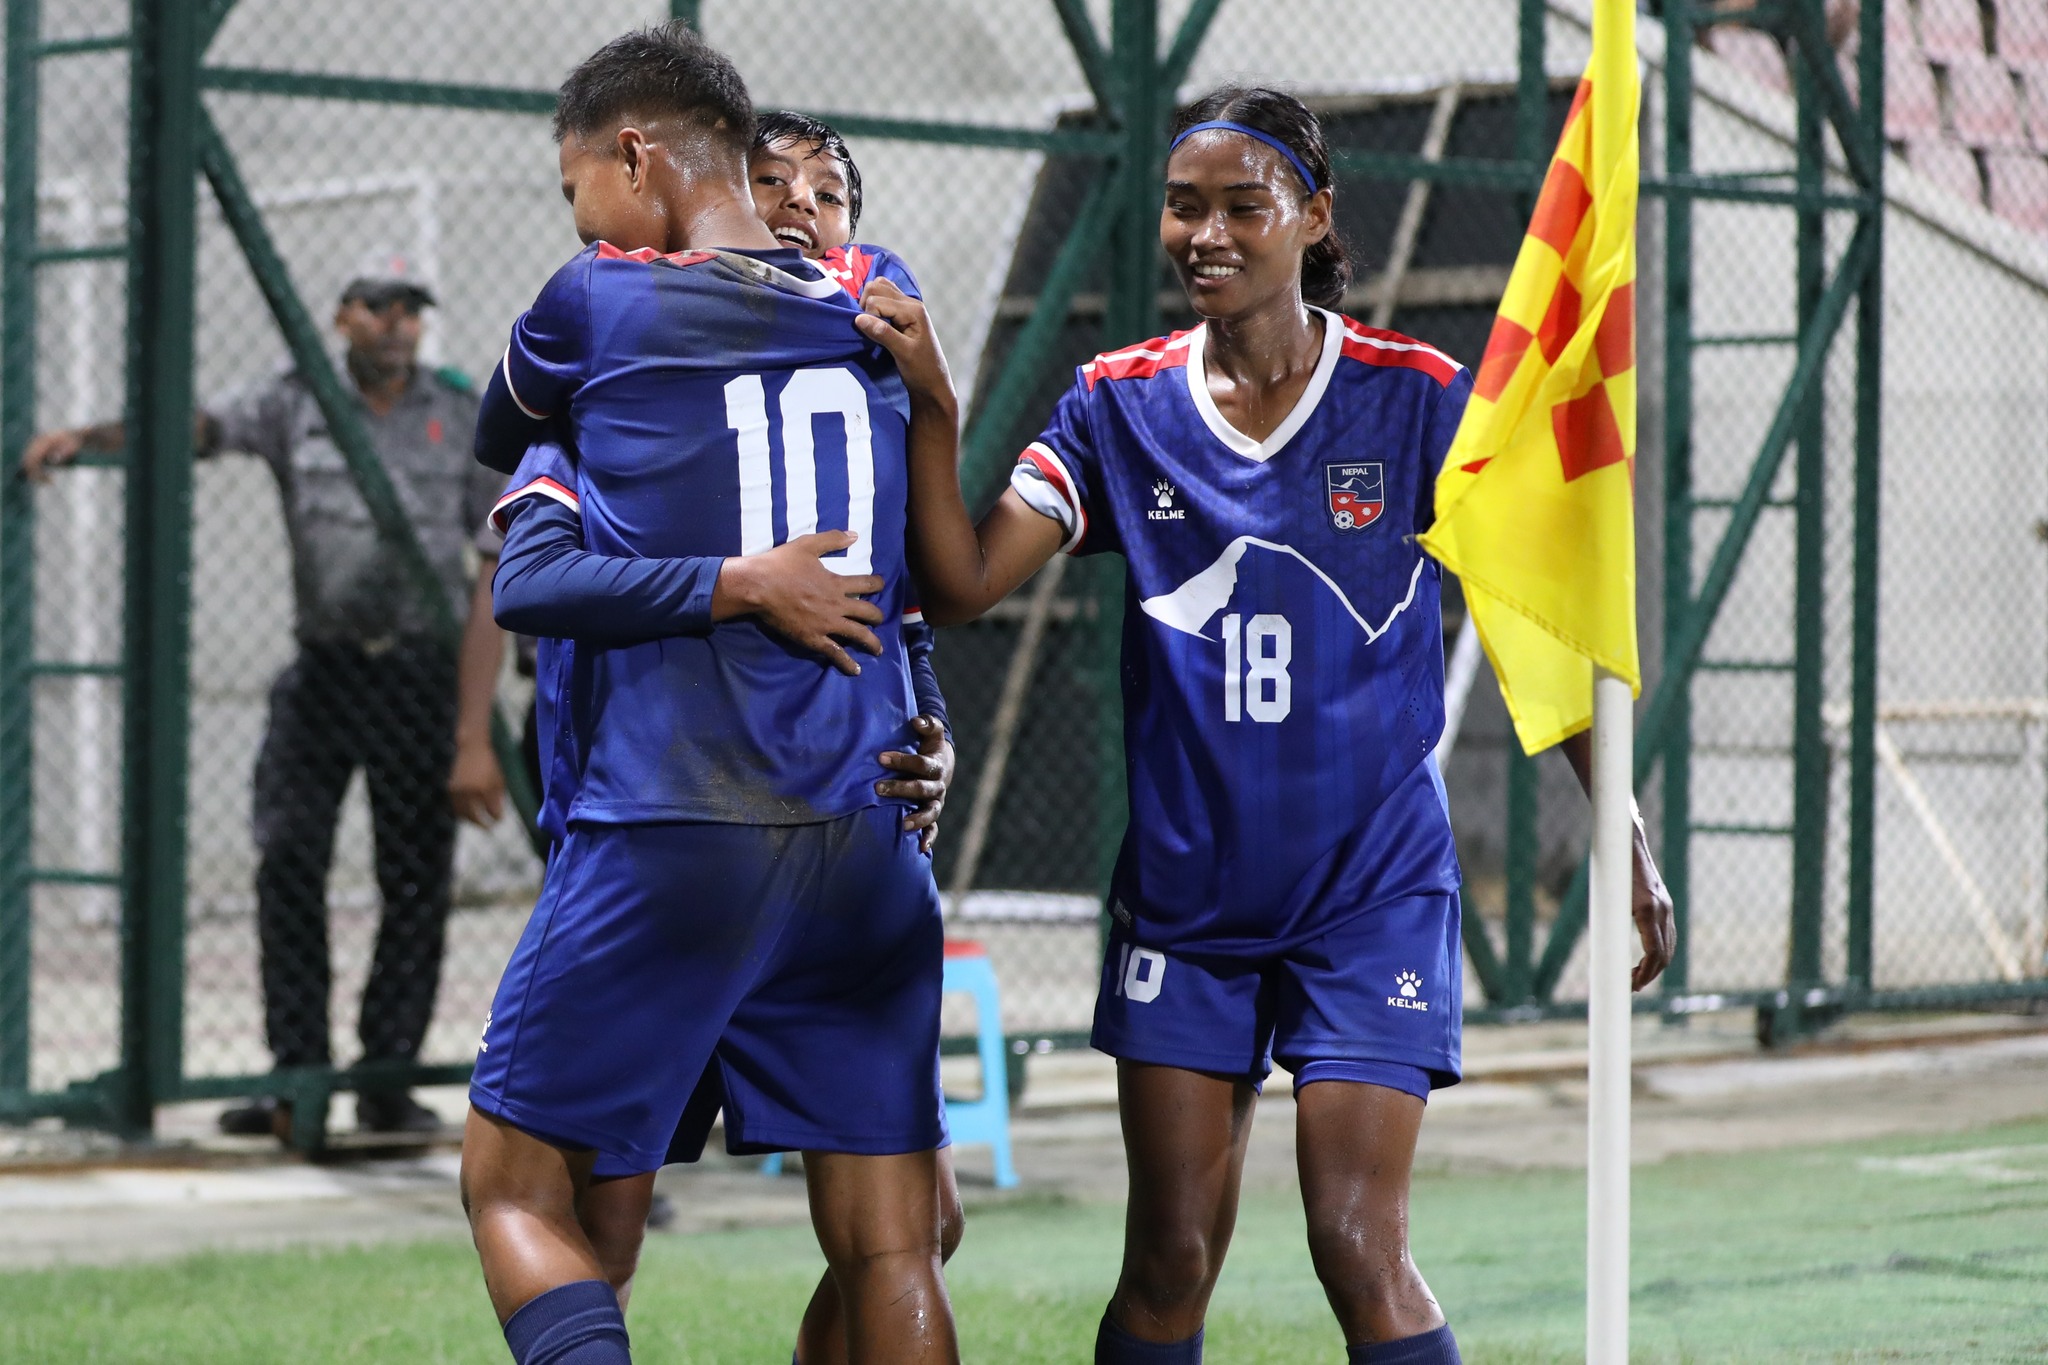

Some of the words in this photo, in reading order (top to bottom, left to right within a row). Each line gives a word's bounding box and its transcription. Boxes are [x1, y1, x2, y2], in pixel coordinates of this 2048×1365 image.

[723, 367, 876, 577] 10
[1341, 467, 1369, 476] NEPAL
[1147, 510, 1185, 520] KELME
[1222, 613, 1292, 723] 18
[1387, 996, 1428, 1011] KELME
